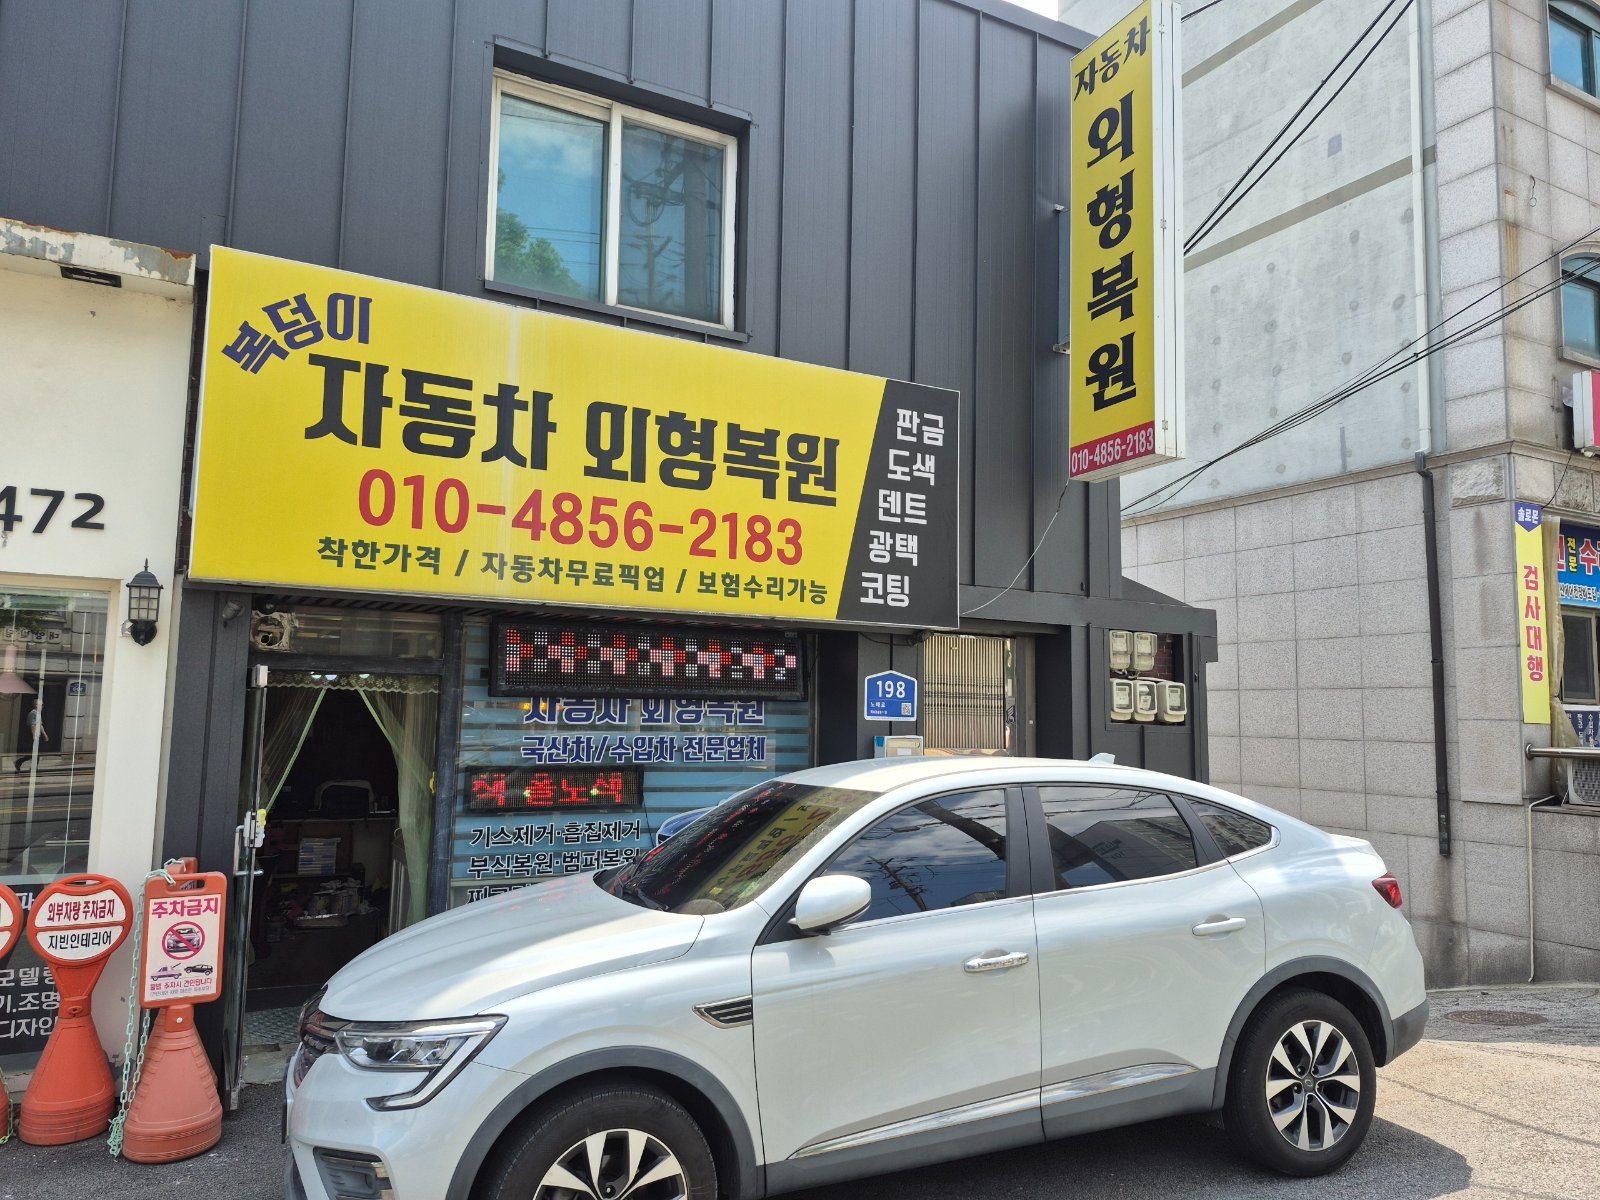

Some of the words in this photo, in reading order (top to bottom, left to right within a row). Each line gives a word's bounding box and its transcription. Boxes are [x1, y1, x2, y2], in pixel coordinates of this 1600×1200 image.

[1073, 16, 1151, 101] 자동차
[1085, 90, 1138, 412] 외형복원
[221, 292, 373, 375] 복덩이
[304, 353, 557, 471] 자동차
[583, 400, 840, 507] 외형복원
[896, 408, 945, 447] 판금
[888, 448, 935, 486] 도색
[1071, 427, 1154, 474] 010-4856-2183
[0, 485, 105, 534] 472
[358, 468, 803, 566] 010-4856-2183
[878, 489, 927, 525] 덴트
[1517, 507, 1539, 525] 솔로몬
[869, 530, 918, 567] 광택
[317, 536, 442, 575] 착한가격
[480, 551, 665, 594] 자동차무료픽업
[698, 571, 828, 606] 보험수리가능
[860, 571, 910, 608] 코팅
[1523, 565, 1543, 682] 검사대행
[876, 680, 906, 698] 198
[521, 735, 678, 764] 국산차/수입차
[683, 735, 767, 763] 전문업체
[47, 900, 81, 923] 외부차량
[82, 898, 115, 920] 주차금지
[151, 896, 219, 919] 주차금지
[47, 930, 112, 950] 지빈인테리어
